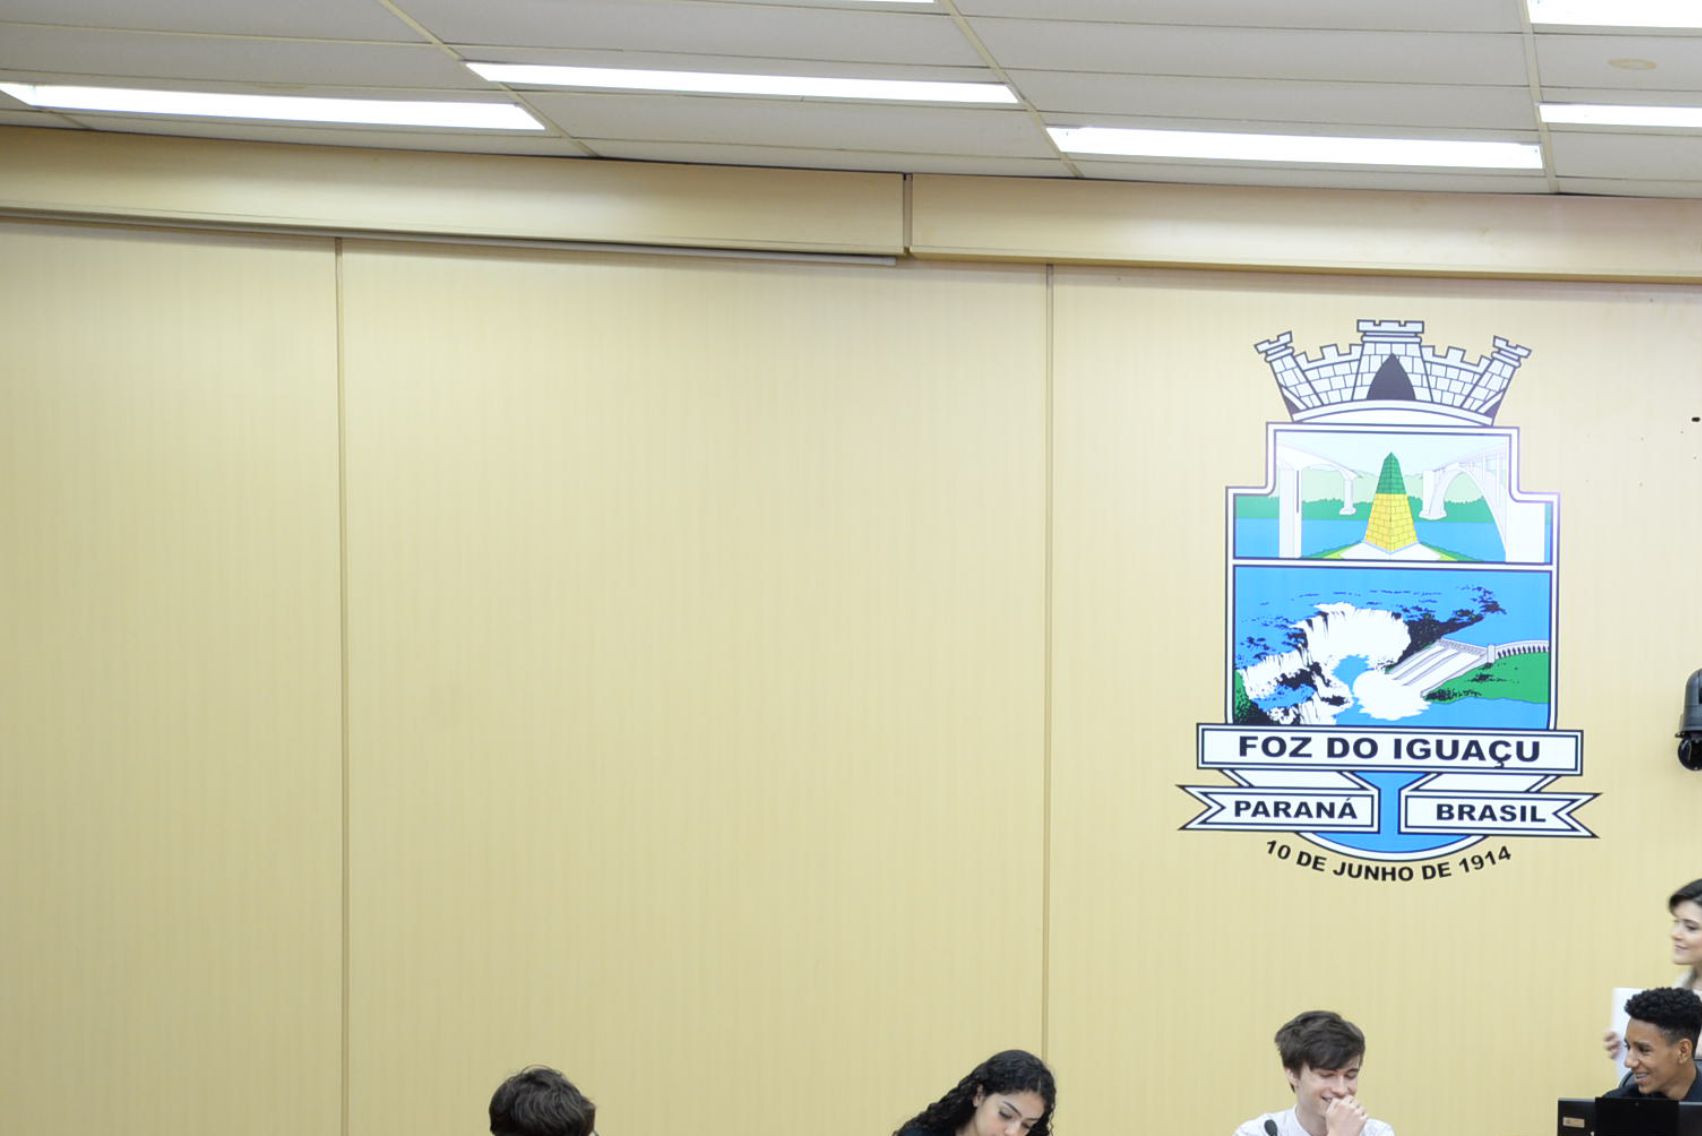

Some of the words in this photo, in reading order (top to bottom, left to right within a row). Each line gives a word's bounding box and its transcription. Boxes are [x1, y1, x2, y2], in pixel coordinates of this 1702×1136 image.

[1238, 735, 1313, 759] FOZ
[1326, 737, 1379, 761] DO
[1393, 737, 1542, 768] IGUAÇU
[1233, 797, 1358, 820] PARANÁ
[1435, 803, 1547, 823] BRASIL
[1266, 839, 1292, 860] 10
[1296, 850, 1327, 872] DE
[1332, 861, 1415, 882] JUNHO
[1421, 861, 1452, 881] DE
[1458, 845, 1512, 873] 1914
